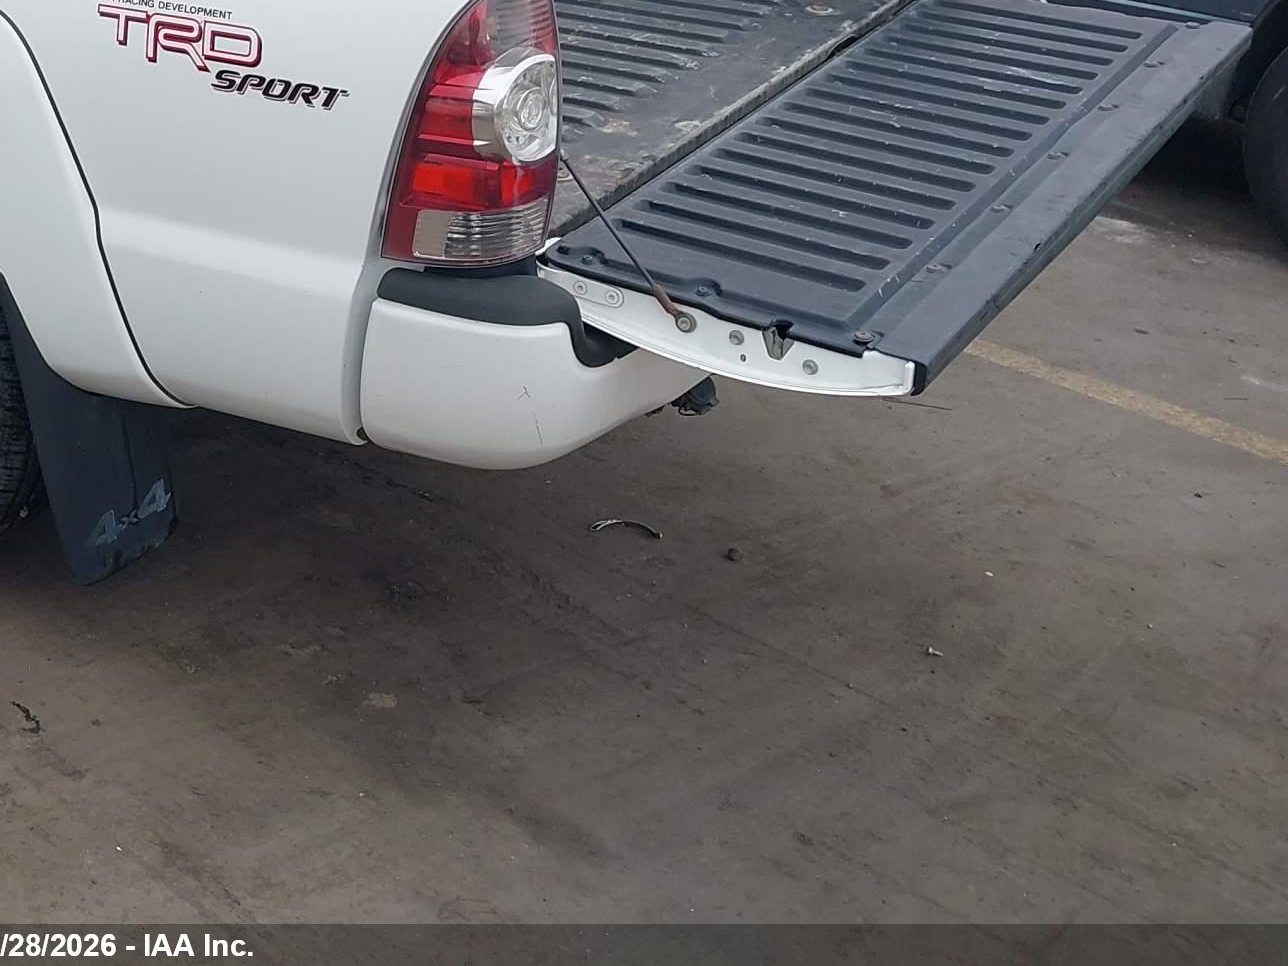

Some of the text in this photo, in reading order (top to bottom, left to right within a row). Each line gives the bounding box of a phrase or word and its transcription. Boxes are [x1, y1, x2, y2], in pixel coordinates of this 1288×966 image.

[158, 0, 233, 20] DEVELOPMENT
[97, 3, 262, 73] TRD
[211, 69, 350, 110] SPORT
